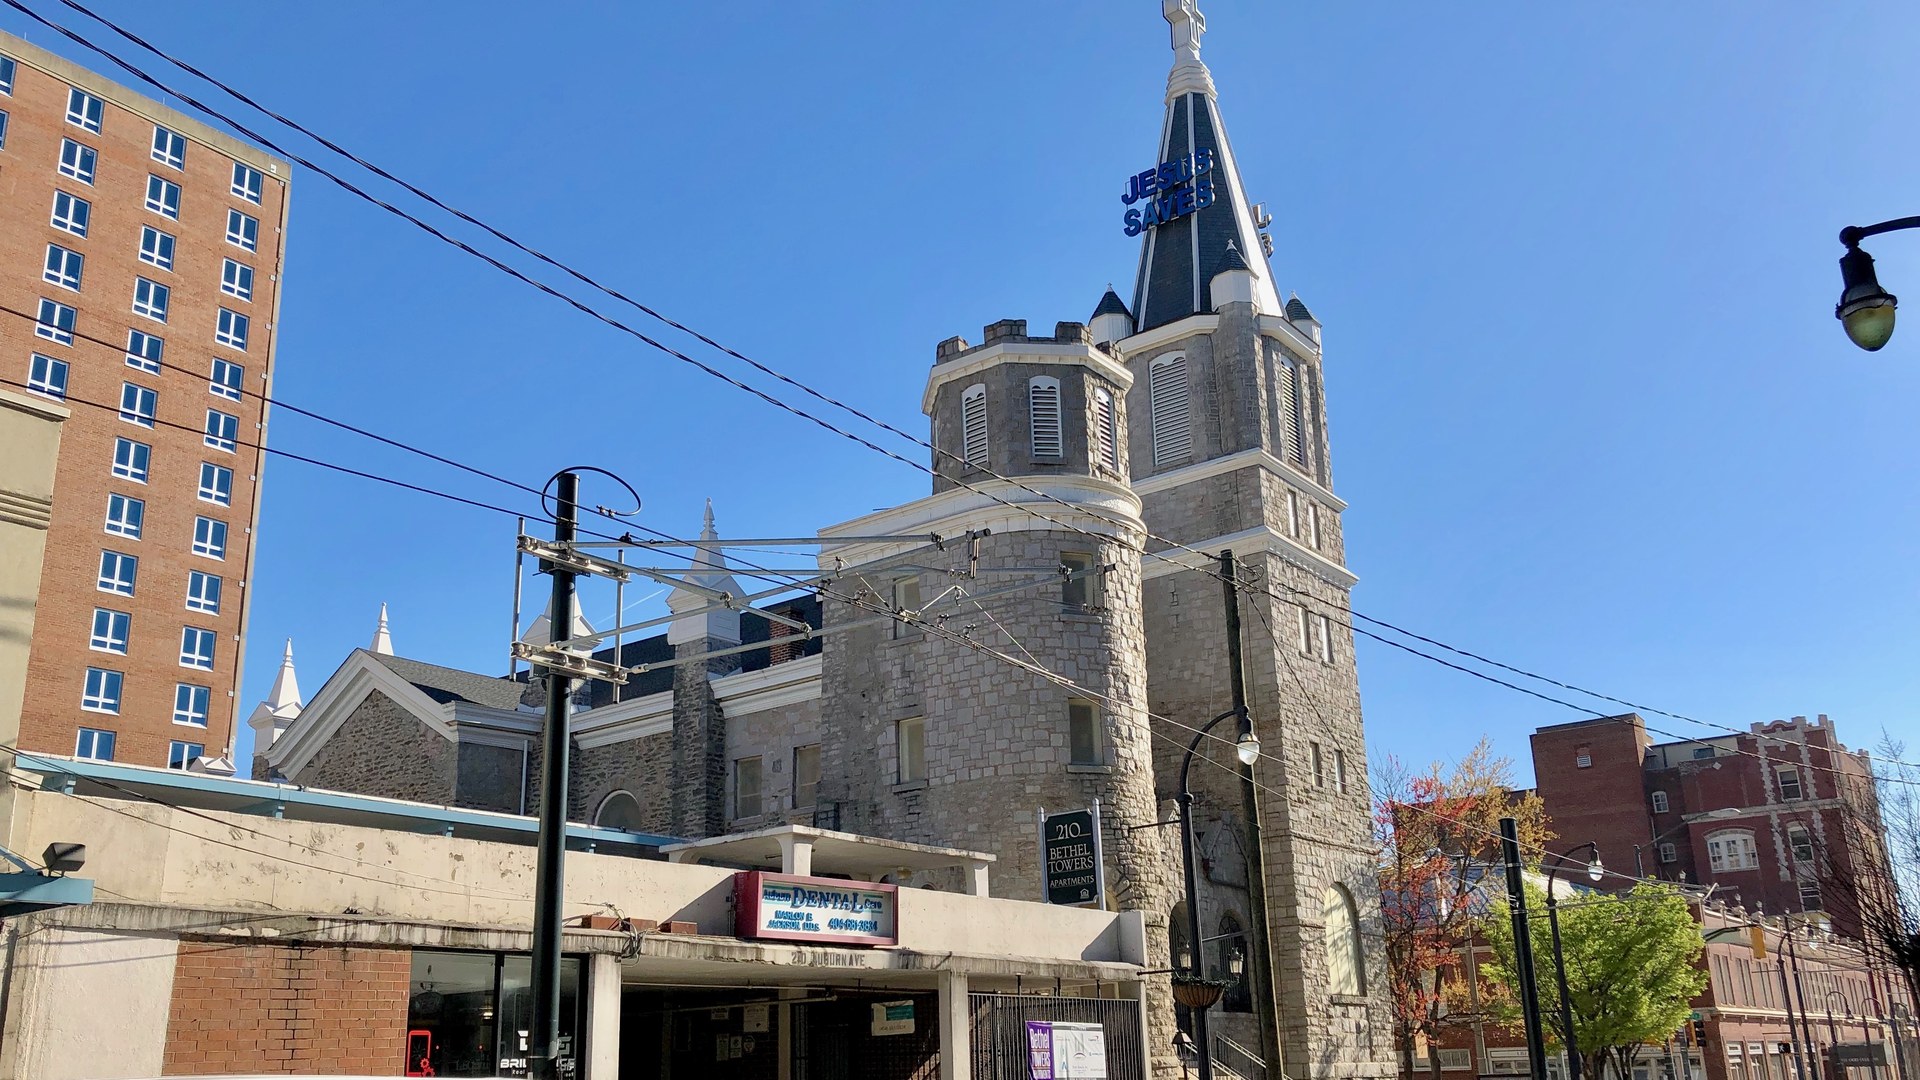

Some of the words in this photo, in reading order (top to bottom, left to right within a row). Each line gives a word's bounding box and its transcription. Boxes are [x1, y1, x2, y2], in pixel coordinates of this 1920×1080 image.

[1121, 147, 1213, 205] JESUS
[1123, 180, 1216, 237] SAVES
[1055, 822, 1081, 840] 210
[1050, 844, 1091, 860] BETHEL
[1048, 856, 1094, 873] TOWERS
[1050, 875, 1095, 889] APARTMENTS
[790, 887, 865, 913] DENTAL
[811, 951, 847, 967] AUBURN
[848, 954, 866, 967] AVE
[1029, 1029, 1050, 1048] Bethel
